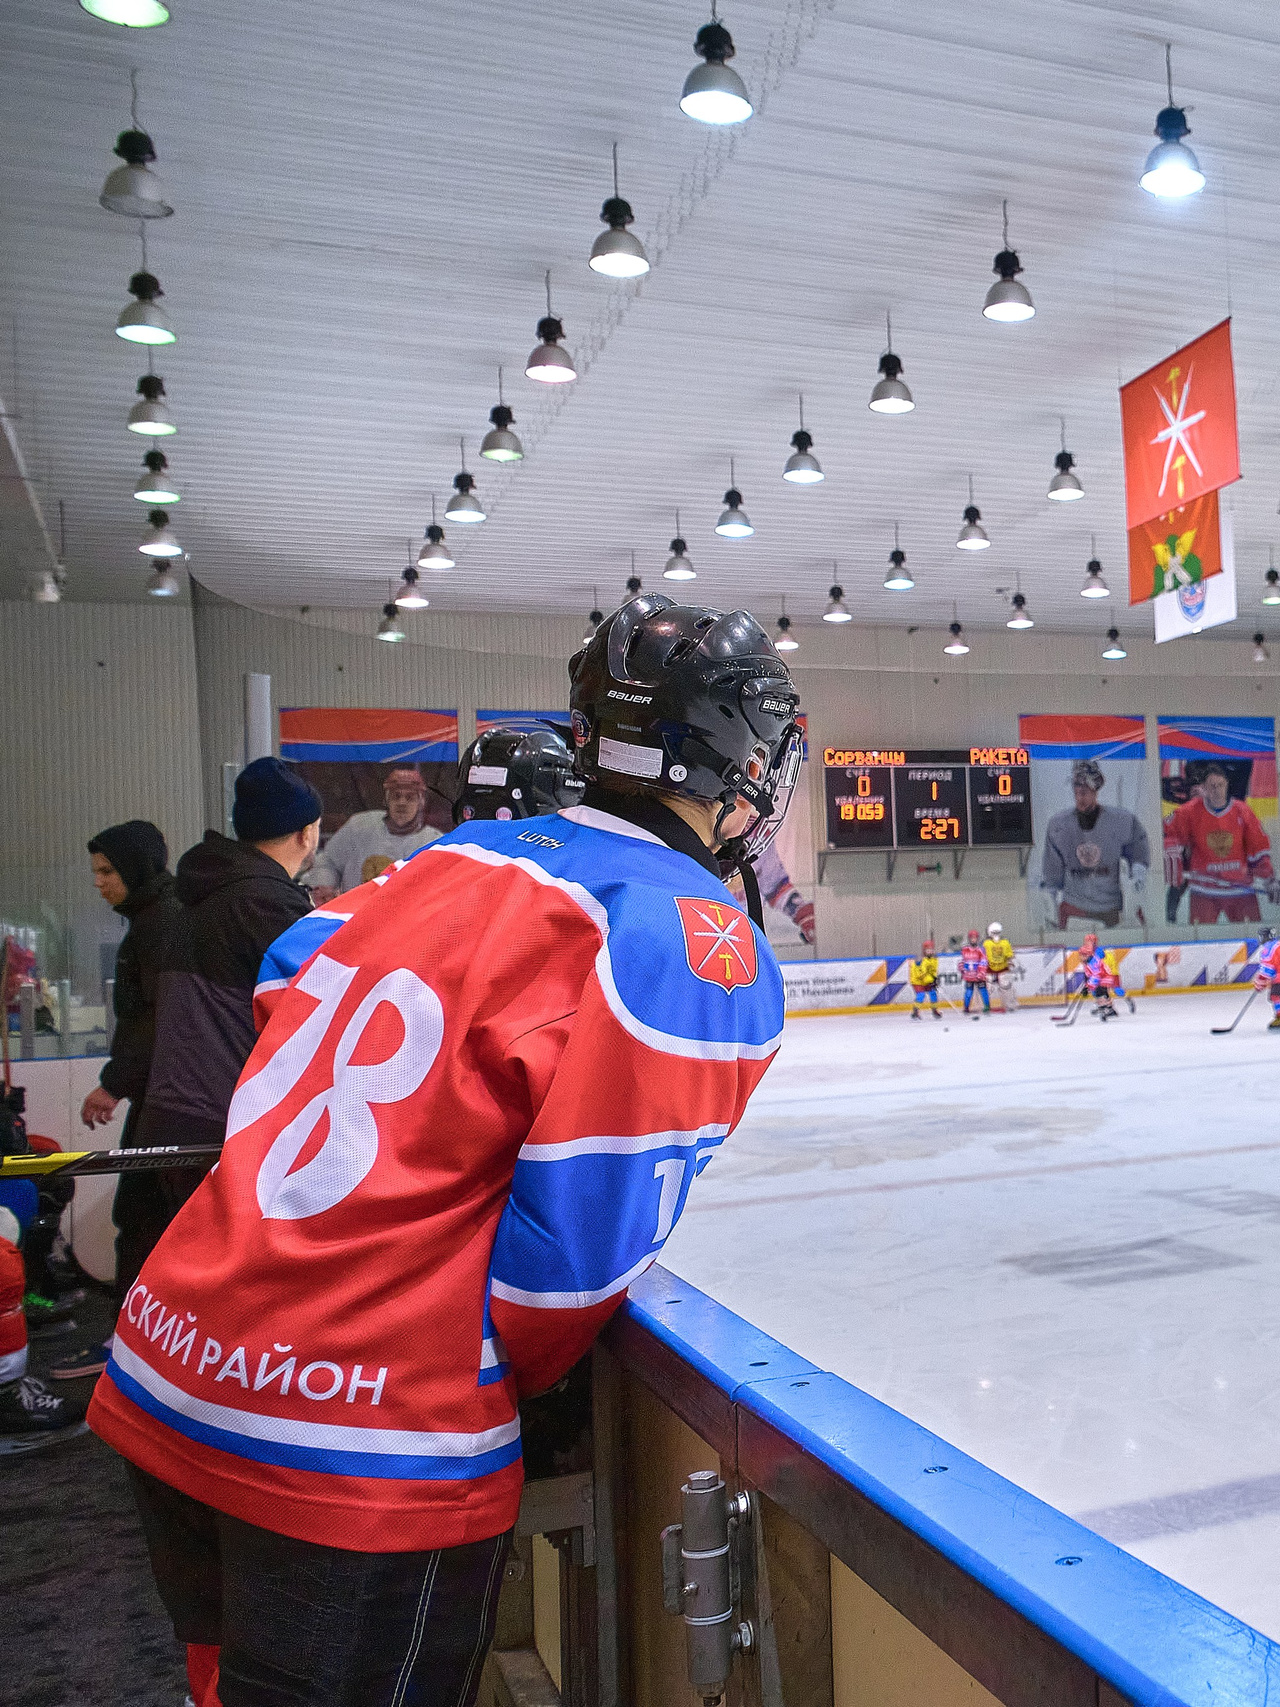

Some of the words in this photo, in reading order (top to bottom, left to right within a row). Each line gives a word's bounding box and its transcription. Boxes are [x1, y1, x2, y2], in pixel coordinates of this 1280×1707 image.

[607, 690, 653, 705] BAUER
[762, 699, 791, 714] BAUER
[970, 748, 1029, 766] РАКЕТА
[908, 770, 953, 781] ПЕРИОД
[998, 774, 1012, 796] 0
[857, 775, 871, 797] 0
[931, 781, 939, 801] 1
[920, 818, 960, 840] 2:27
[516, 830, 565, 850] LUTCH
[108, 1145, 180, 1156] BAUER
[196, 1342, 389, 1406] РАЙОН
